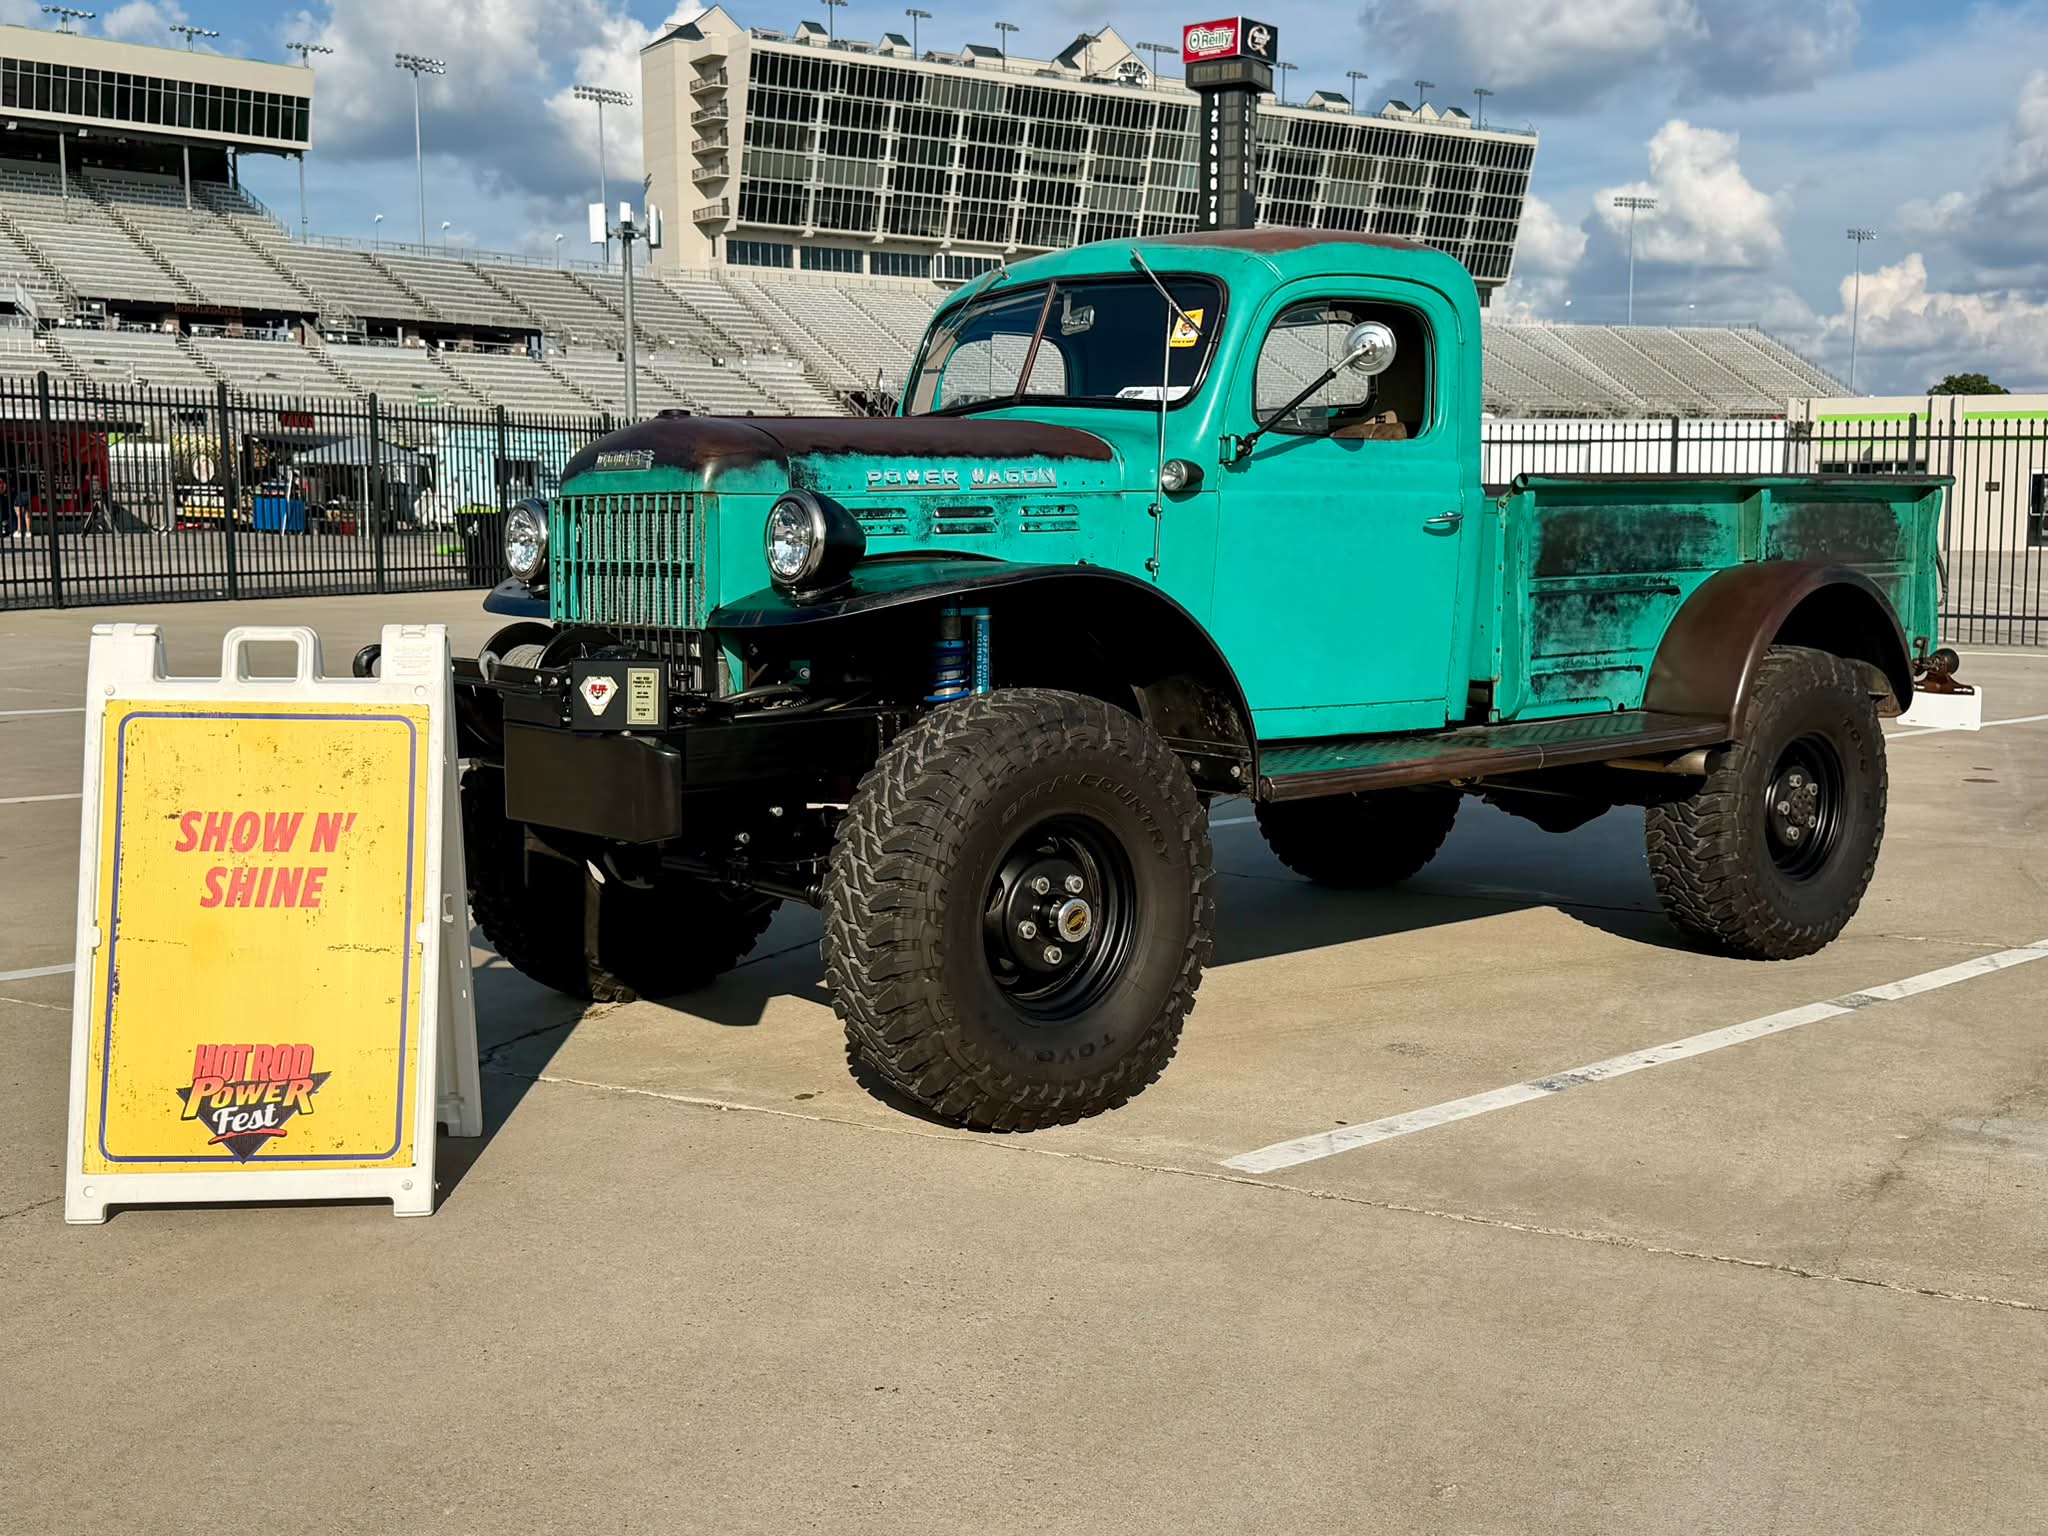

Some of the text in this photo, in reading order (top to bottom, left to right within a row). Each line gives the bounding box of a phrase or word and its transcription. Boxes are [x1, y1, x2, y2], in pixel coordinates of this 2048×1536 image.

[1188, 28, 1232, 51] O'Reilly
[1213, 93, 1219, 107] 1
[1211, 109, 1218, 122] 2
[1211, 127, 1218, 140] 3
[1210, 143, 1217, 156] 4
[1210, 162, 1218, 175] 5
[1209, 196, 1217, 209] 7
[866, 467, 1057, 484] POWER WAGON
[175, 811, 357, 853] SHOW N'
[200, 867, 328, 908] SHINE
[193, 1044, 314, 1081] HOT ROD
[212, 1104, 279, 1135] Fest
